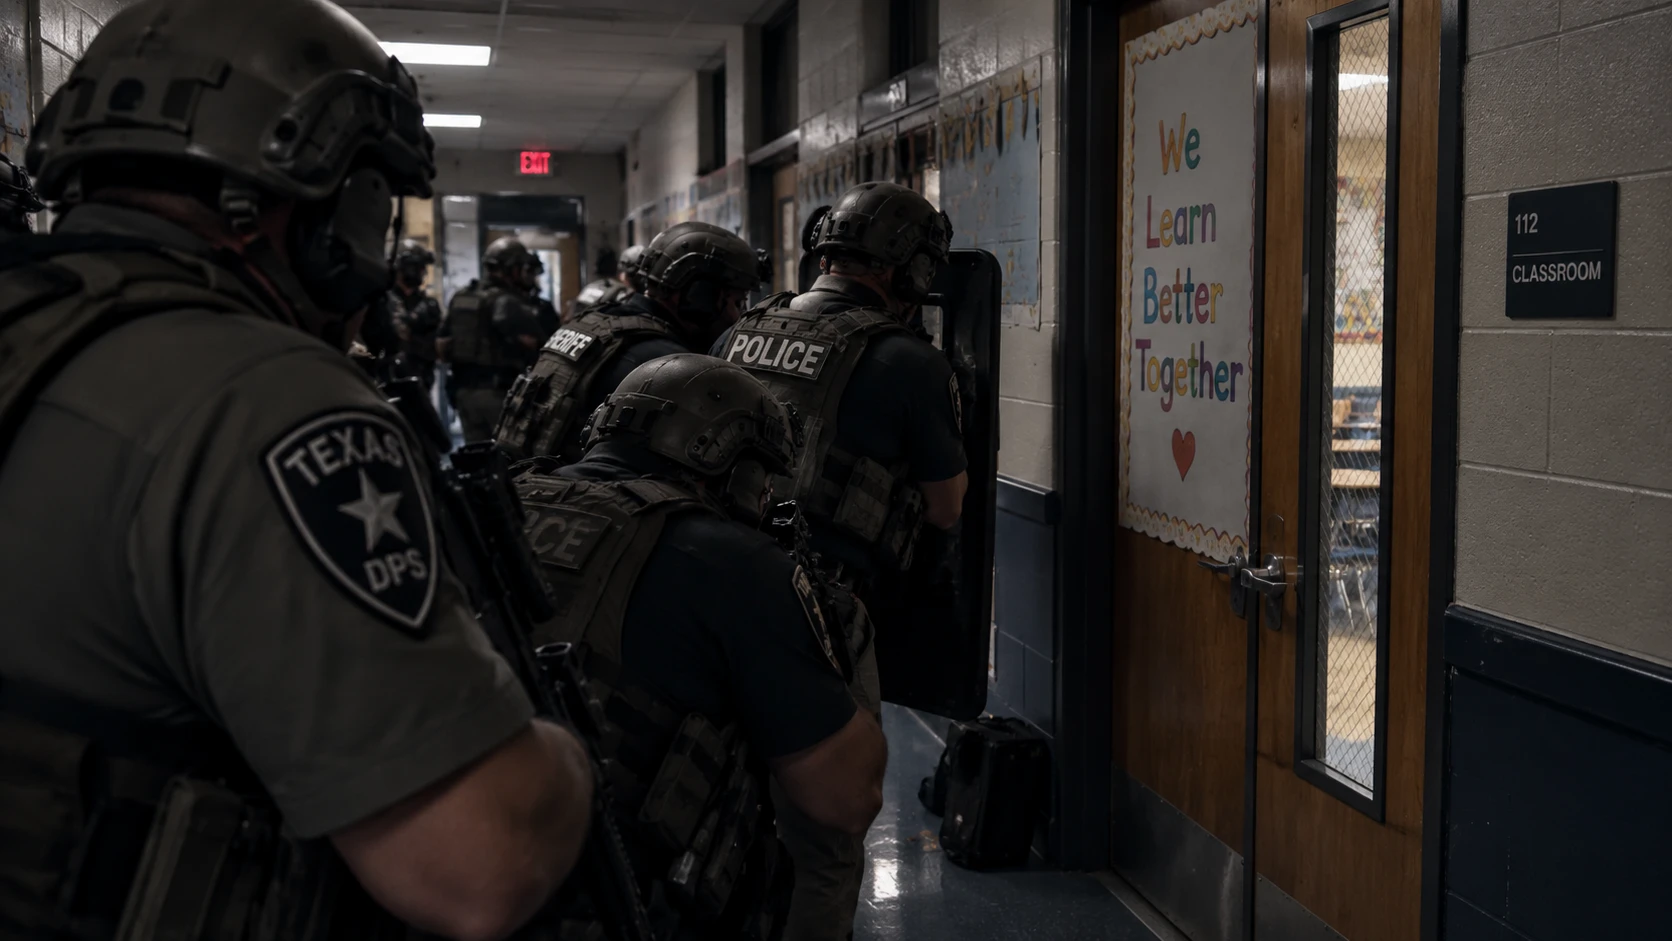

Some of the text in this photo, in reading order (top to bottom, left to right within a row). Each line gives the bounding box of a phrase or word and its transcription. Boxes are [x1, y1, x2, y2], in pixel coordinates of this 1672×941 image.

[519, 151, 551, 174] EXIT
[1159, 112, 1201, 175] We
[1146, 195, 1216, 248] Learn
[1515, 212, 1539, 234] 112
[1143, 267, 1224, 324] Better
[1512, 260, 1602, 283] CLASSROOM
[726, 334, 825, 375] POLICE
[1135, 339, 1244, 412] Together
[282, 424, 404, 487] TEXAS
[362, 547, 428, 593] DPS
